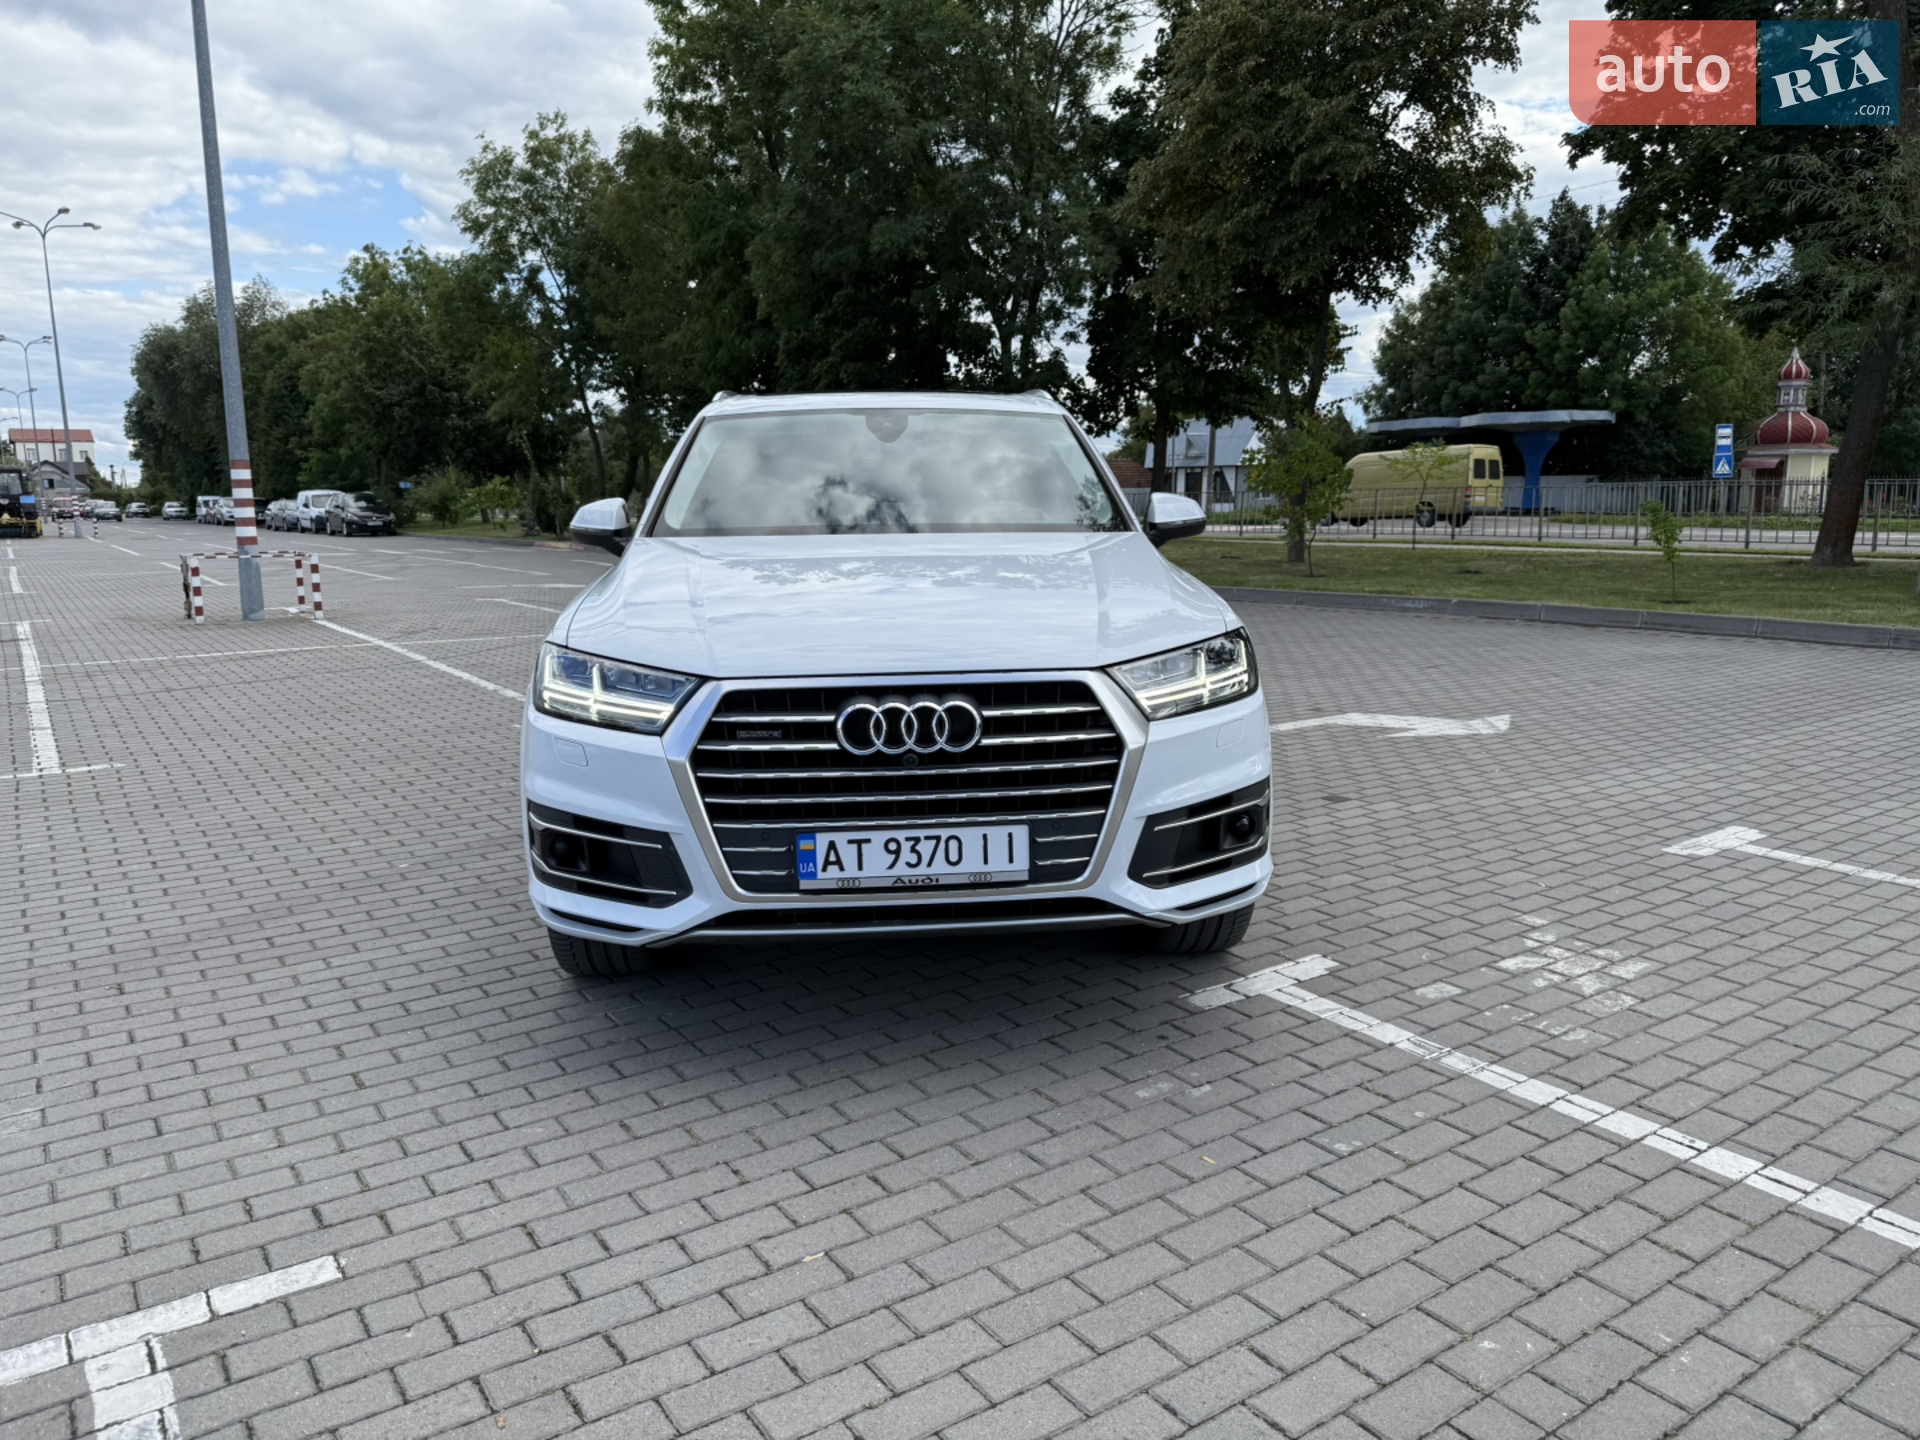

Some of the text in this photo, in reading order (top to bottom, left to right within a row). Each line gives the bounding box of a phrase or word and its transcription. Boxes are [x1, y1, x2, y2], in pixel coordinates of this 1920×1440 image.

[821, 838, 872, 872] AT
[883, 834, 963, 870] 9370
[799, 862, 816, 873] UA
[892, 876, 940, 886] Audi
